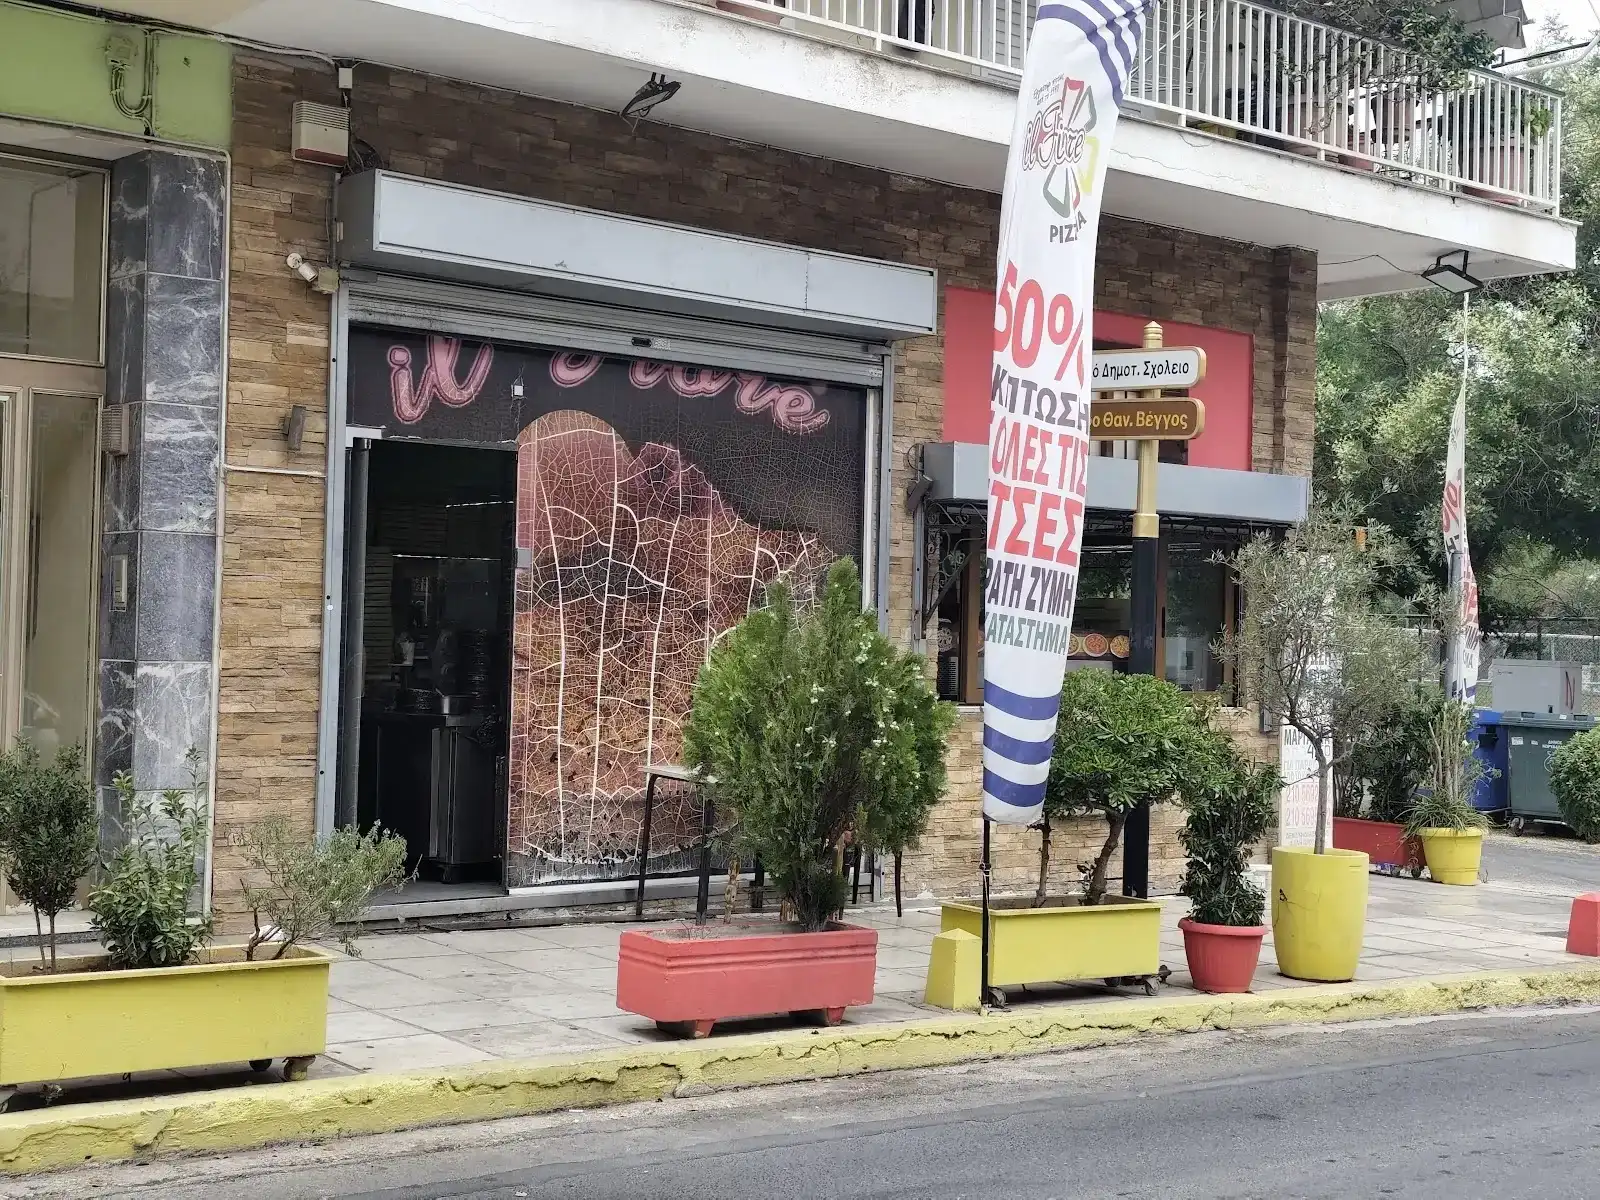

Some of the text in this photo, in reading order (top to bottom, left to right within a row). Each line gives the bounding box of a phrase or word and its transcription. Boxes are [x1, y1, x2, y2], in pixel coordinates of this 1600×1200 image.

[1102, 362, 1140, 380] Δημοτ.
[1143, 359, 1190, 379] Σχολειο
[1103, 411, 1133, 427] Θαν.
[1136, 410, 1188, 430] Βέγγος
[992, 416, 1088, 497] ΟΛΕΣ ΤΙΣ
[988, 480, 1083, 567] ΤΣΕΣ
[1025, 566, 1075, 619] ΖΥΜΗ
